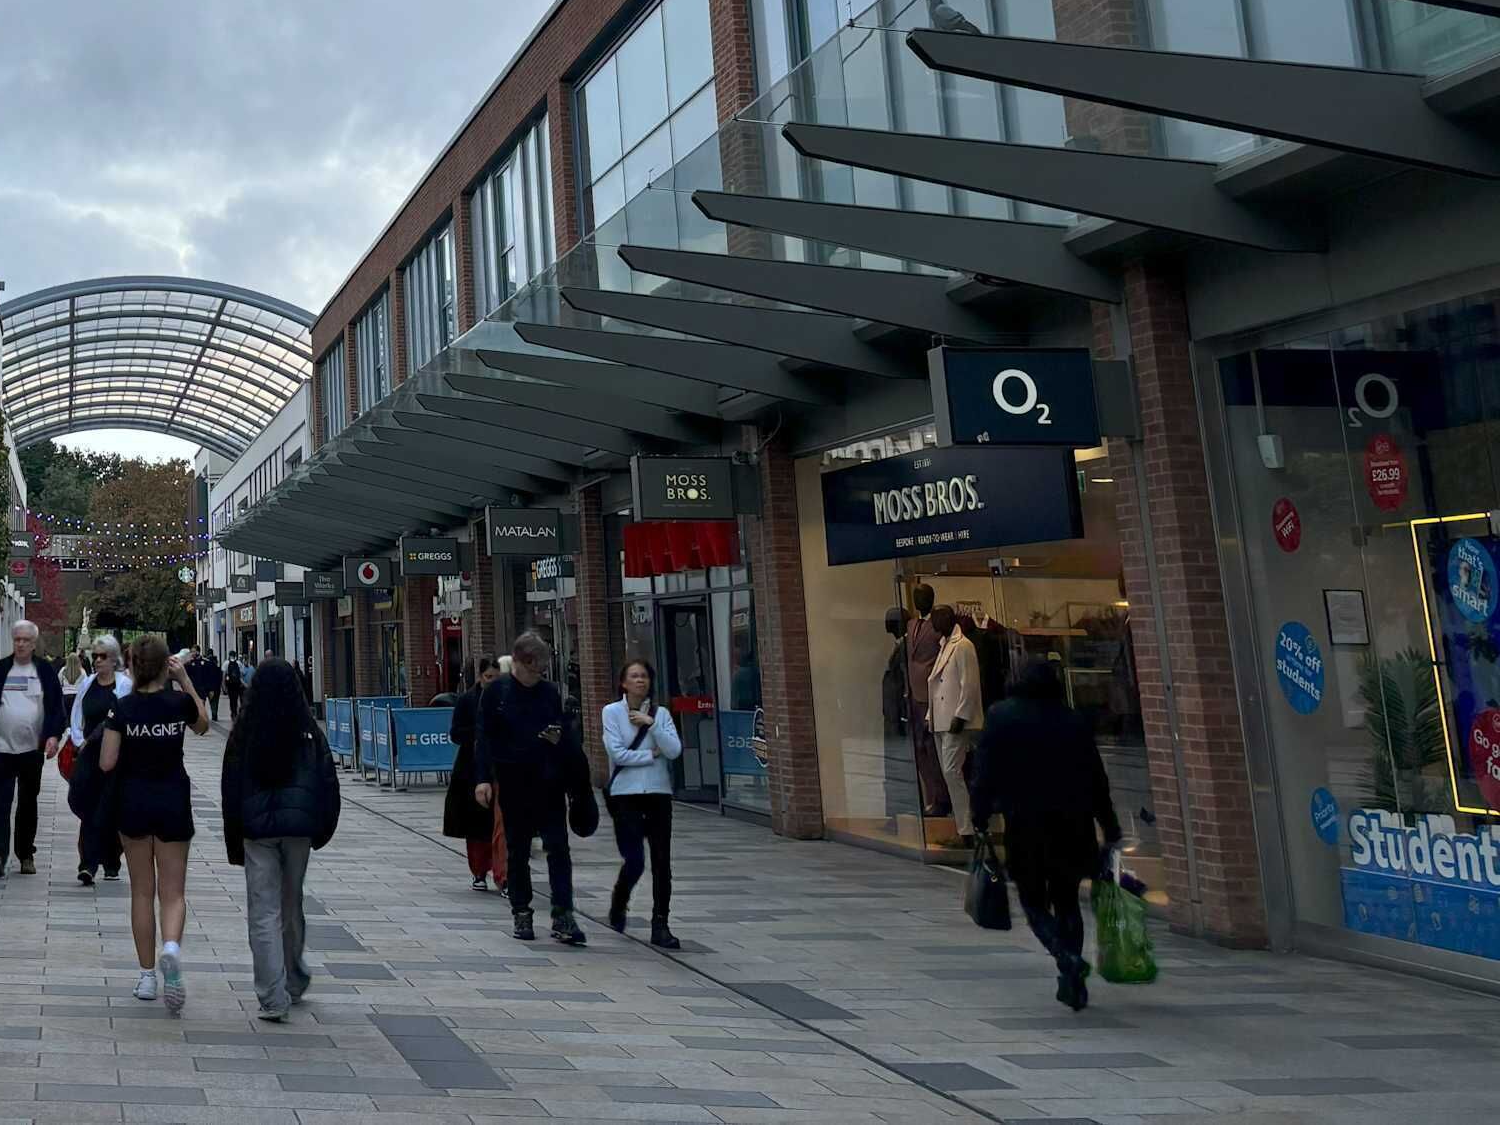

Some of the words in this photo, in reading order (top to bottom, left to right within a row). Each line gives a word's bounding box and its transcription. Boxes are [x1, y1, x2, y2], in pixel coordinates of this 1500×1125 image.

[992, 368, 1053, 425] O2
[666, 474, 707, 486] MOSS
[1371, 467, 1400, 482] £26.99
[872, 484, 923, 525] MOSS
[494, 525, 557, 538] MATALAN
[417, 552, 453, 561] GREGGS
[1457, 546, 1485, 572] that's
[314, 582, 335, 590] Works
[1452, 585, 1489, 618] smart
[1278, 631, 1305, 663] 20%
[1304, 655, 1322, 674] off
[1275, 657, 1322, 702] students
[126, 720, 186, 737] MAGNET
[1473, 728, 1490, 750] Go
